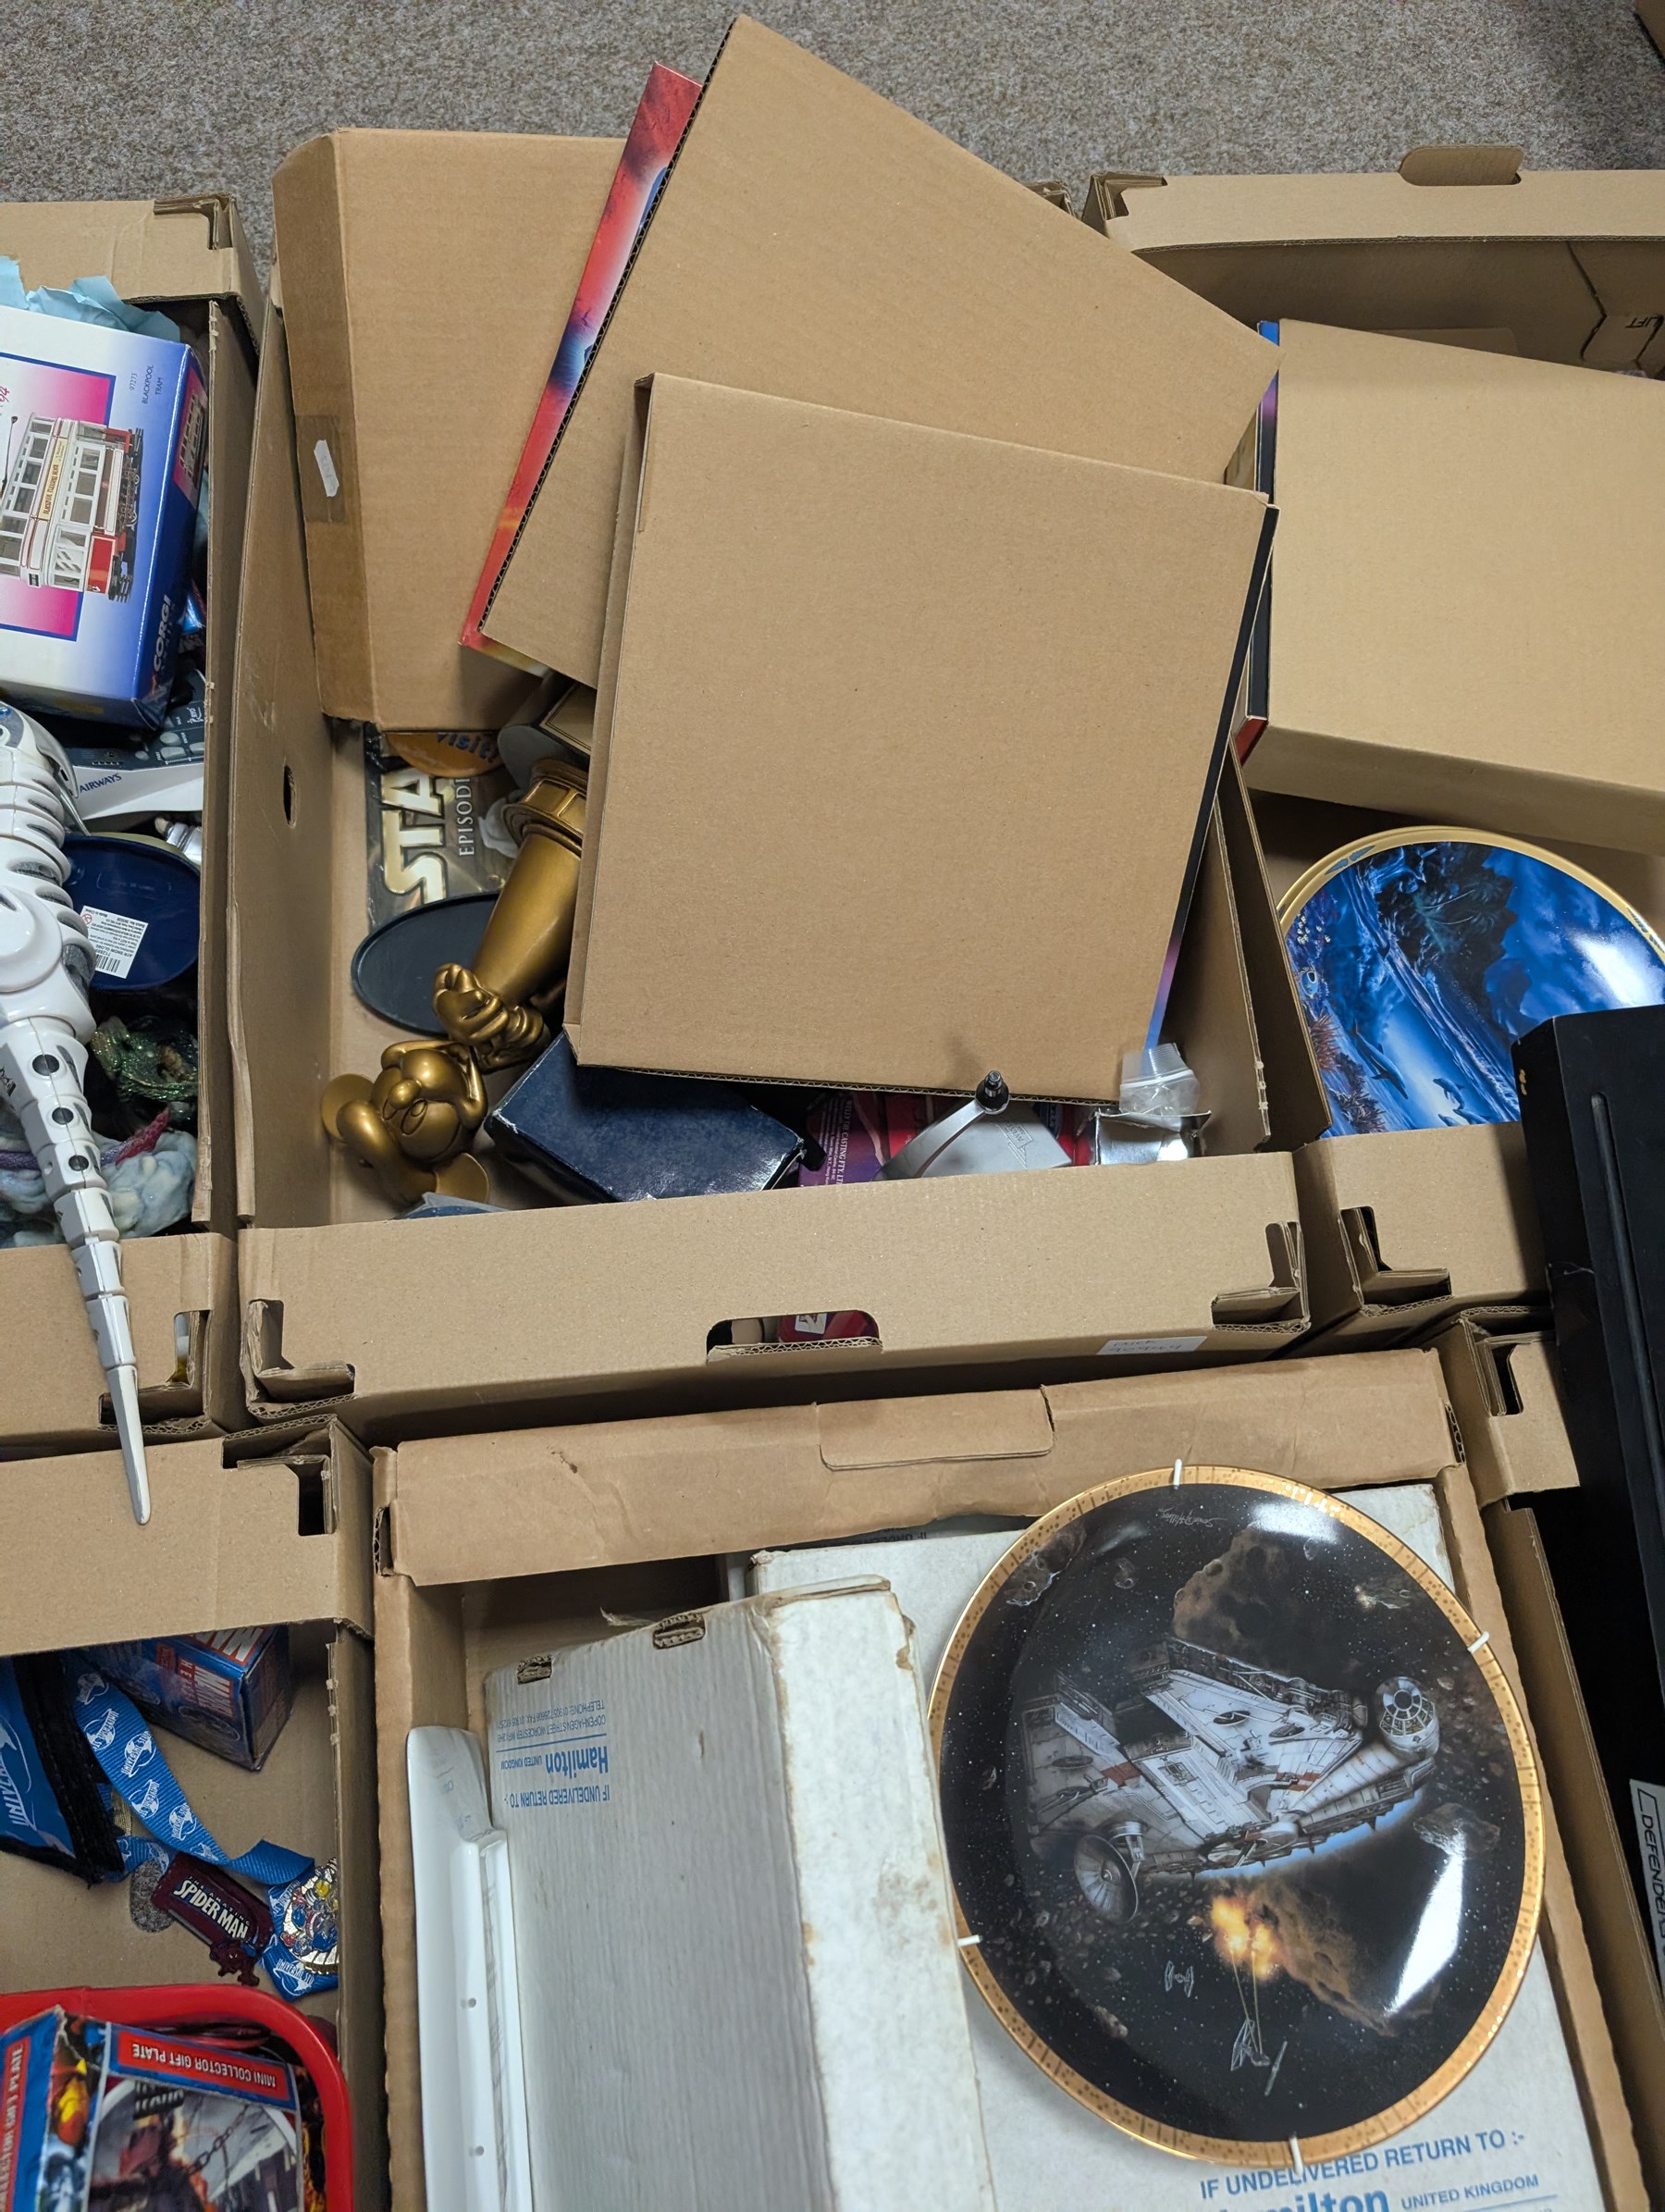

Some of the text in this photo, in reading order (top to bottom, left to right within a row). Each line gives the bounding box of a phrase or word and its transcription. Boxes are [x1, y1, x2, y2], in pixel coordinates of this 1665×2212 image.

[129, 373, 138, 390] 97273
[142, 365, 154, 404] BLACKPOOL
[154, 377, 164, 395] TRAM
[153, 595, 172, 672] CORGI
[80, 773, 121, 793] AIRWAYS
[456, 778, 475, 856] EPISOD
[381, 768, 447, 904] STA
[839, 1132, 848, 1160] CASTING
[516, 1726, 545, 1739] WORCESTER
[547, 1722, 565, 1735] STREET
[566, 1715, 606, 1730] COPENHAGEN
[500, 1746, 609, 1779] Hamilton UNITED KINGDOM
[510, 1793, 519, 1808] TO
[521, 1790, 547, 1807] RETURN
[549, 1786, 600, 1805] UNDELIVERED
[602, 1785, 610, 1802] IF
[174, 1880, 249, 1939] SPIDER MAN
[209, 1892, 250, 1926] AMAZING
[8, 2044, 23, 2092] PLATE
[132, 2044, 278, 2087] MINI COLLECTOR GIFT PLATE
[1201, 2180, 1219, 2199] IF
[1226, 2152, 1378, 2196] UNDELIVERED
[1386, 2135, 1471, 2169] RETURN
[1475, 2130, 1505, 2150] TO
[1401, 2189, 1460, 2210] UNITED
[1464, 2173, 1539, 2198] KINGDOM
